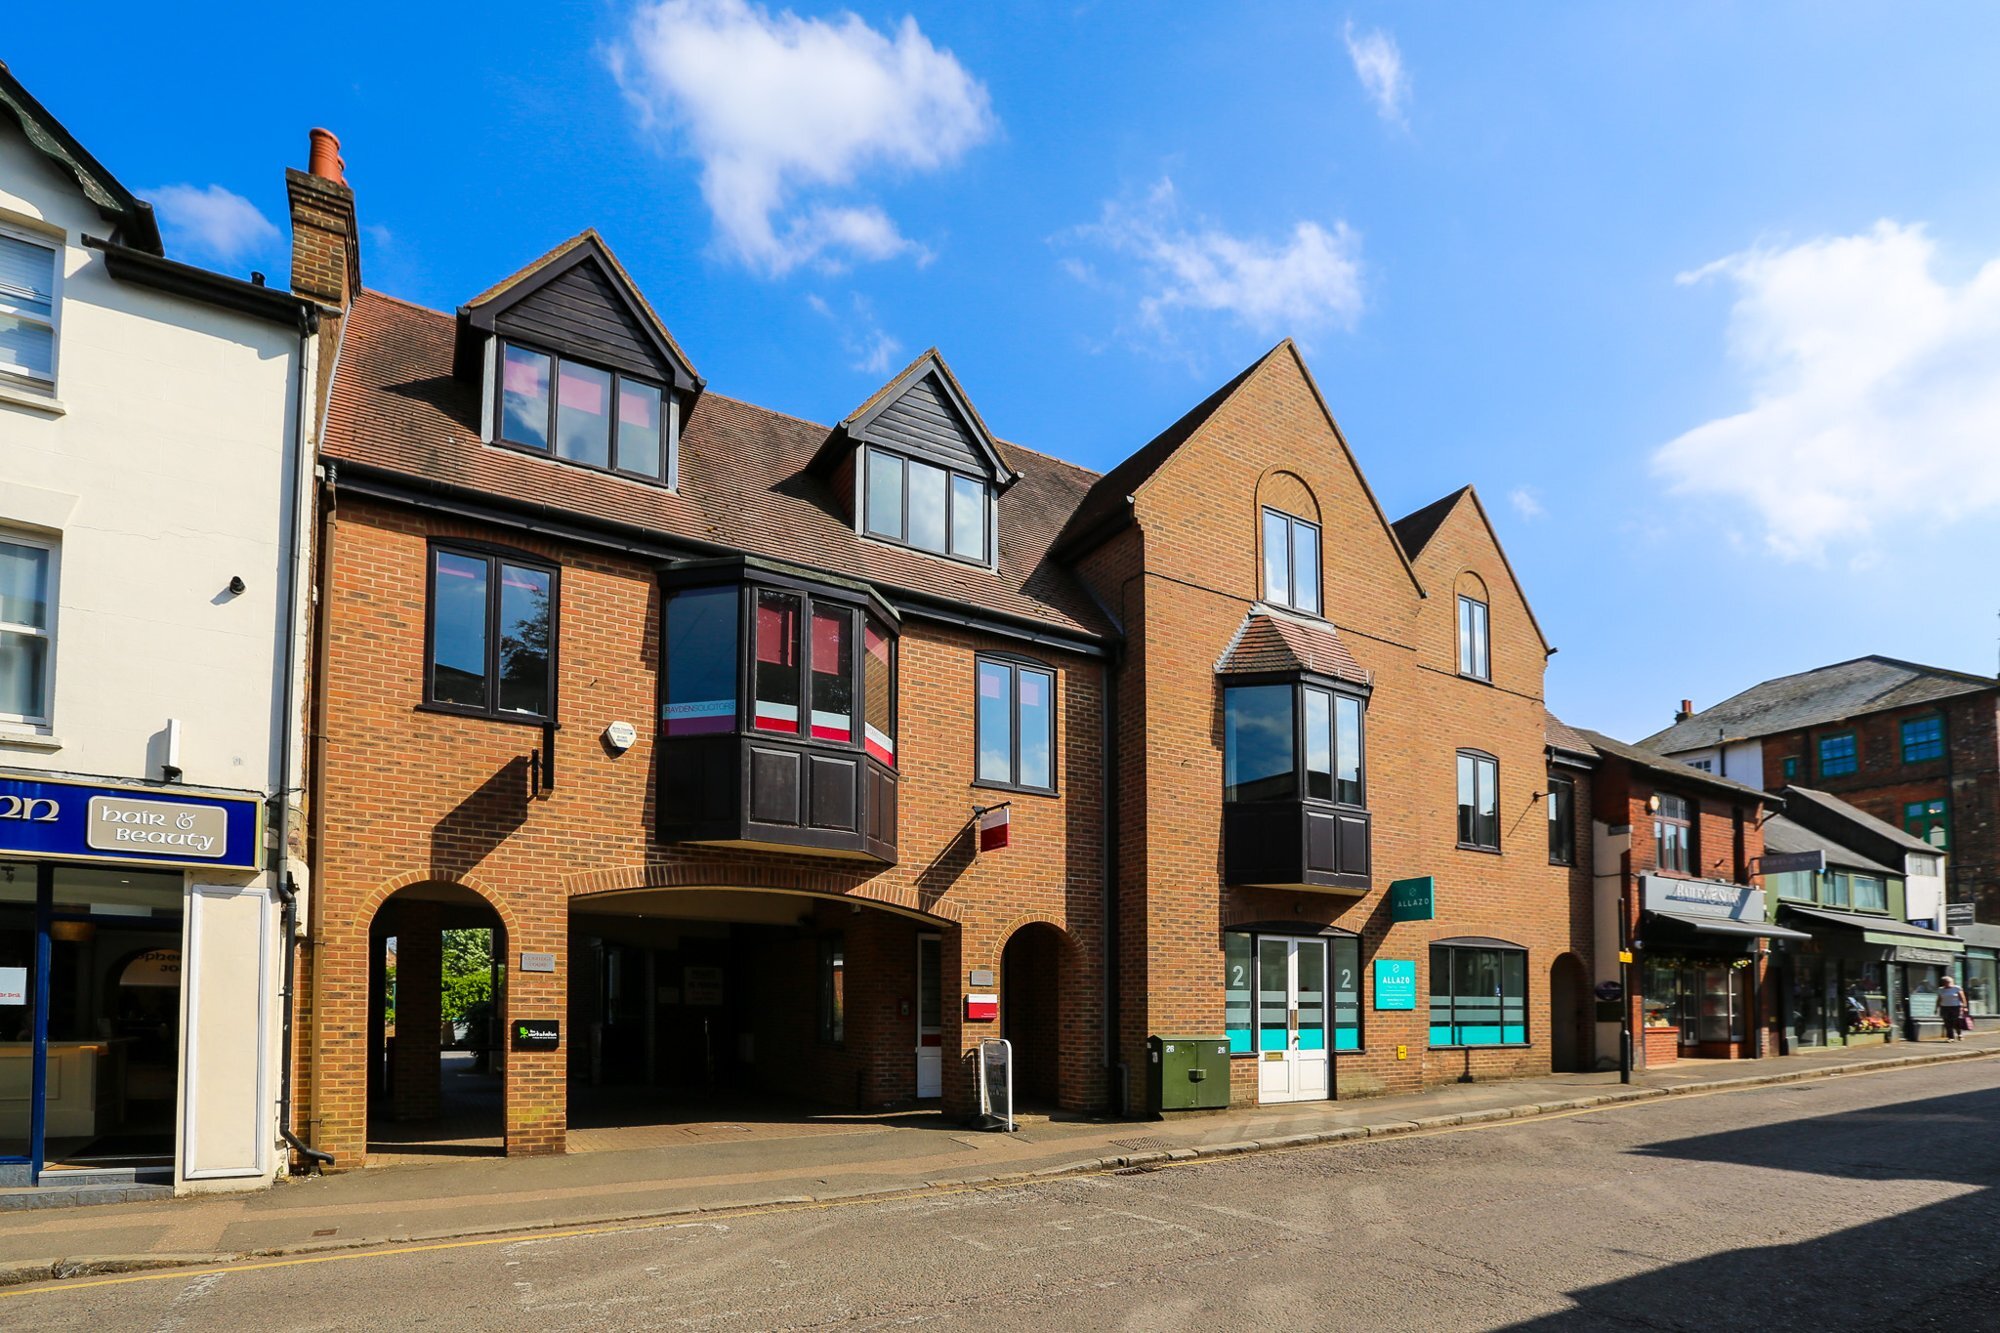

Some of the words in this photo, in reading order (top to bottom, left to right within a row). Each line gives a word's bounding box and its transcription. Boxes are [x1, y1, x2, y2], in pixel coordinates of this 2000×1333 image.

[176, 812, 196, 830] &
[116, 827, 214, 852] Beauty
[1397, 897, 1430, 907] ALLAZO
[1232, 965, 1245, 987] 2
[1341, 968, 1351, 988] 2
[1382, 976, 1410, 985] ALLAZO
